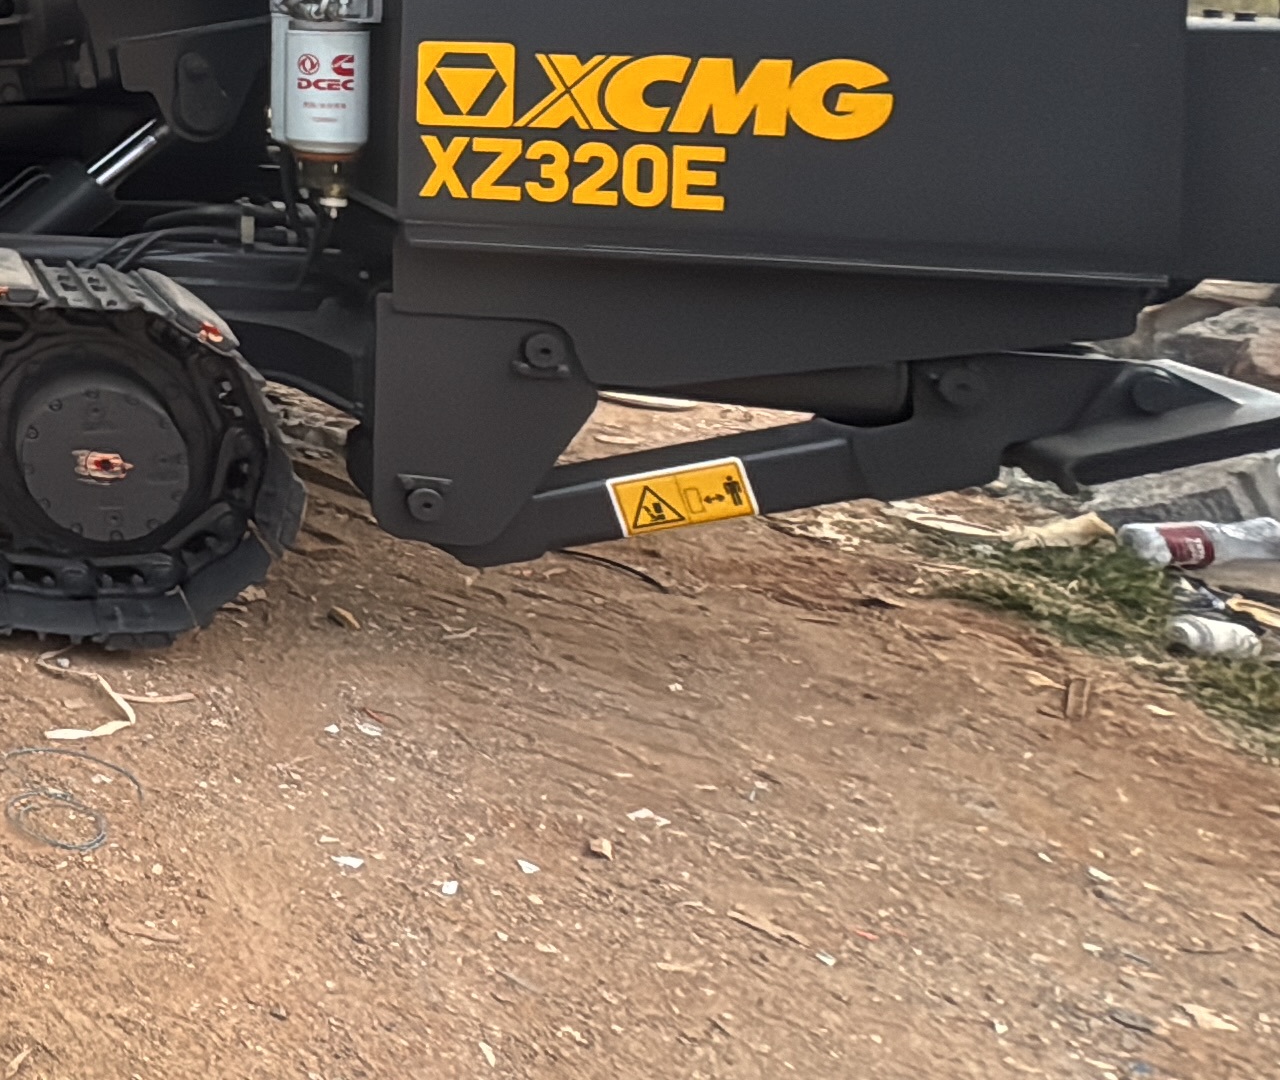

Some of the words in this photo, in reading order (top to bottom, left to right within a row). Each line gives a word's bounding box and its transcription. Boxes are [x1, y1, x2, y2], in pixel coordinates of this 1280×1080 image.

[297, 78, 354, 90] DCEC
[512, 53, 893, 140] XCMG
[419, 135, 726, 211] XZ320E
